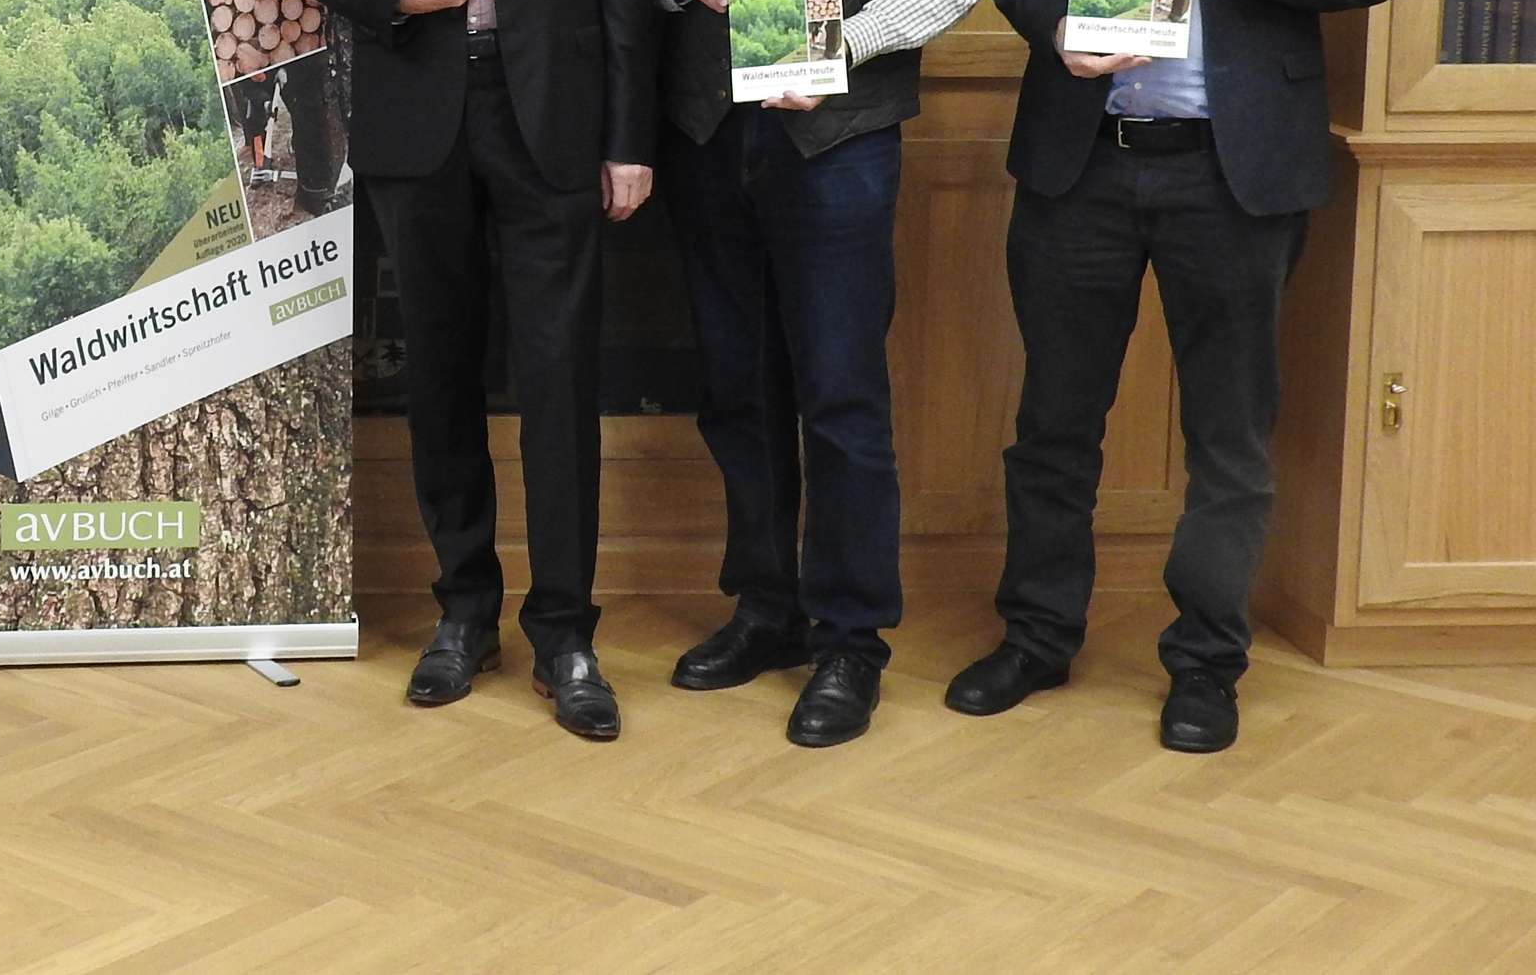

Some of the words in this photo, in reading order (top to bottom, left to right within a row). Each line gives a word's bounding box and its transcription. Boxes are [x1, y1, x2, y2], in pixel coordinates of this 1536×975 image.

[205, 199, 241, 229] NEU
[29, 269, 251, 386] Waldwirtschaft
[258, 238, 339, 288] heute
[275, 284, 342, 321] avBUCH
[41, 405, 65, 422] Gilge
[70, 389, 102, 409] Grulich
[107, 371, 139, 391] Pfeiffer
[144, 354, 177, 374] Sandler
[182, 331, 231, 358] Spreitzhofer
[15, 510, 184, 543] avBUCH
[10, 557, 191, 581] www.avbuch.at
